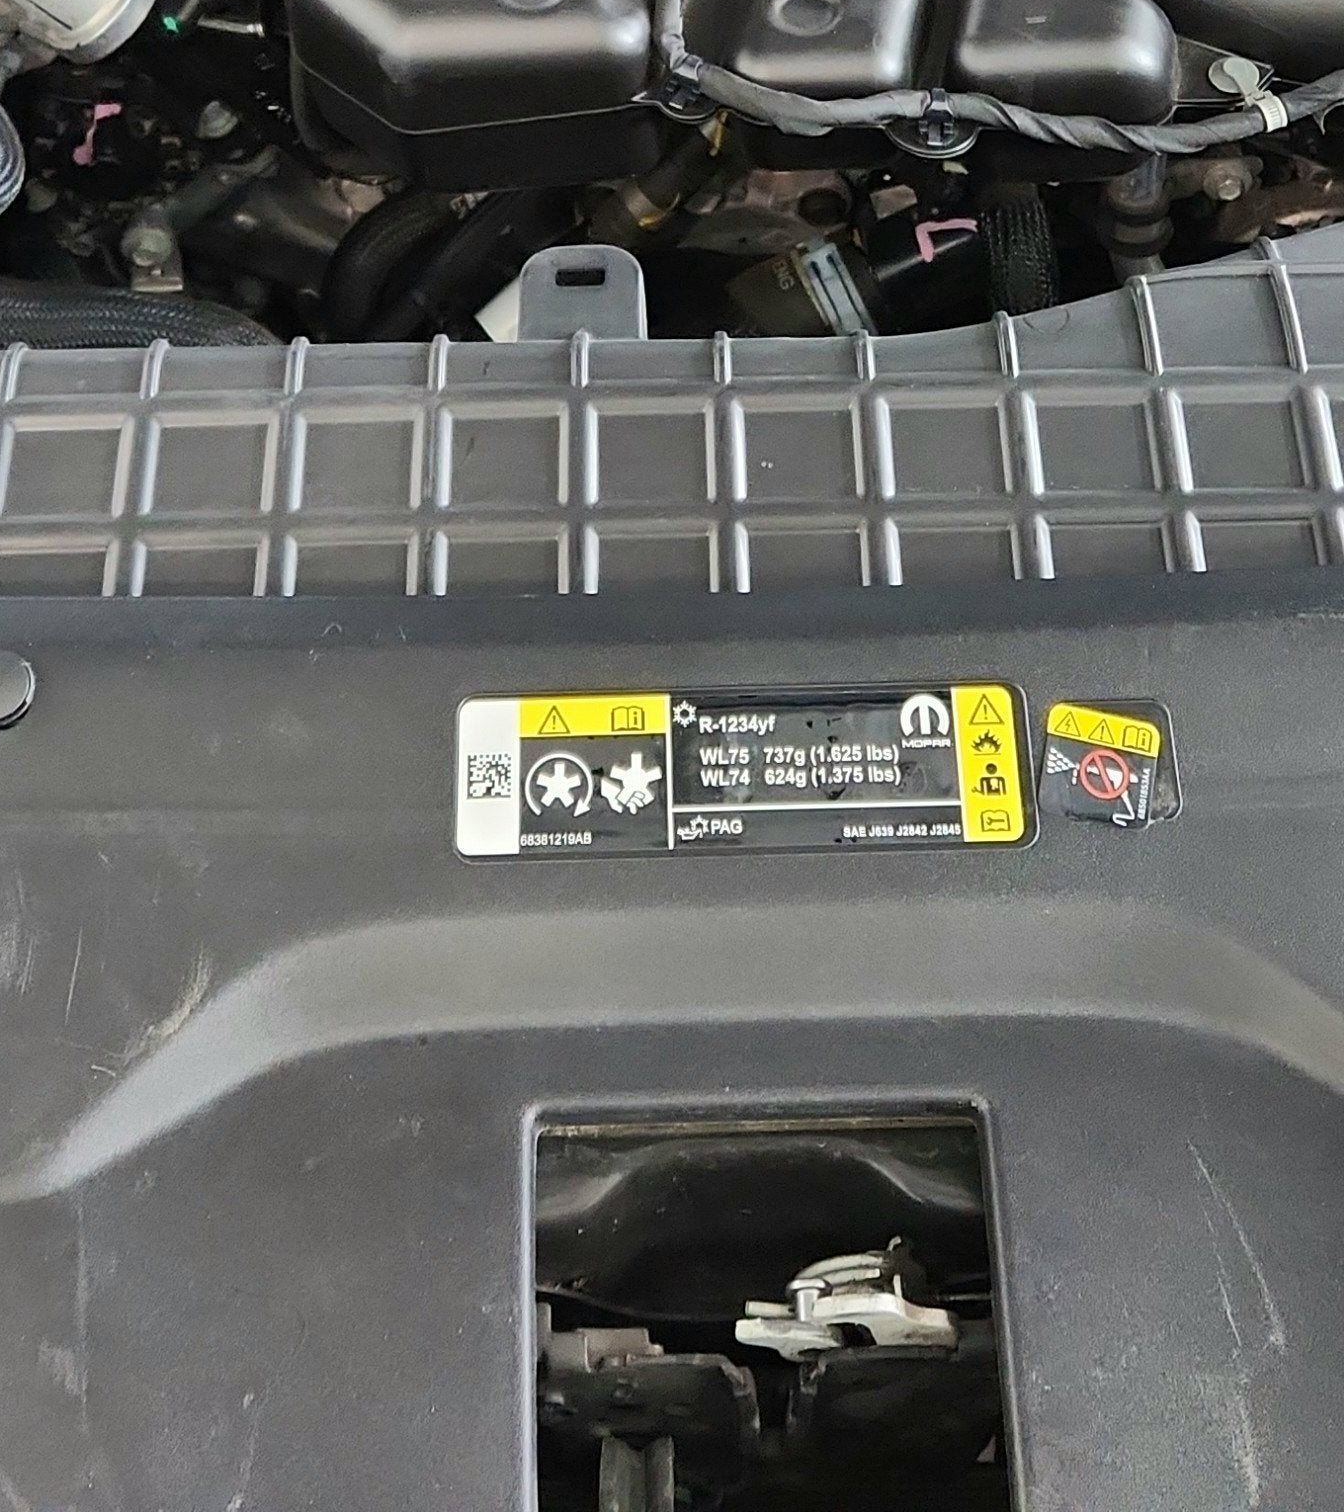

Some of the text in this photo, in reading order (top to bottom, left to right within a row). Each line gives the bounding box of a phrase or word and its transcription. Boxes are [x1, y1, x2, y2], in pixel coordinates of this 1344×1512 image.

[698, 714, 776, 736] R-1234yf
[901, 738, 951, 749] MOPAR
[698, 744, 900, 767] WL75 737g (1.625 lbs)
[700, 765, 902, 788] WL74 624g (1.375 lbs)
[710, 819, 744, 835] PAG
[842, 824, 867, 838] SAE
[868, 825, 895, 837] J639
[520, 831, 592, 847] 68381219AB
